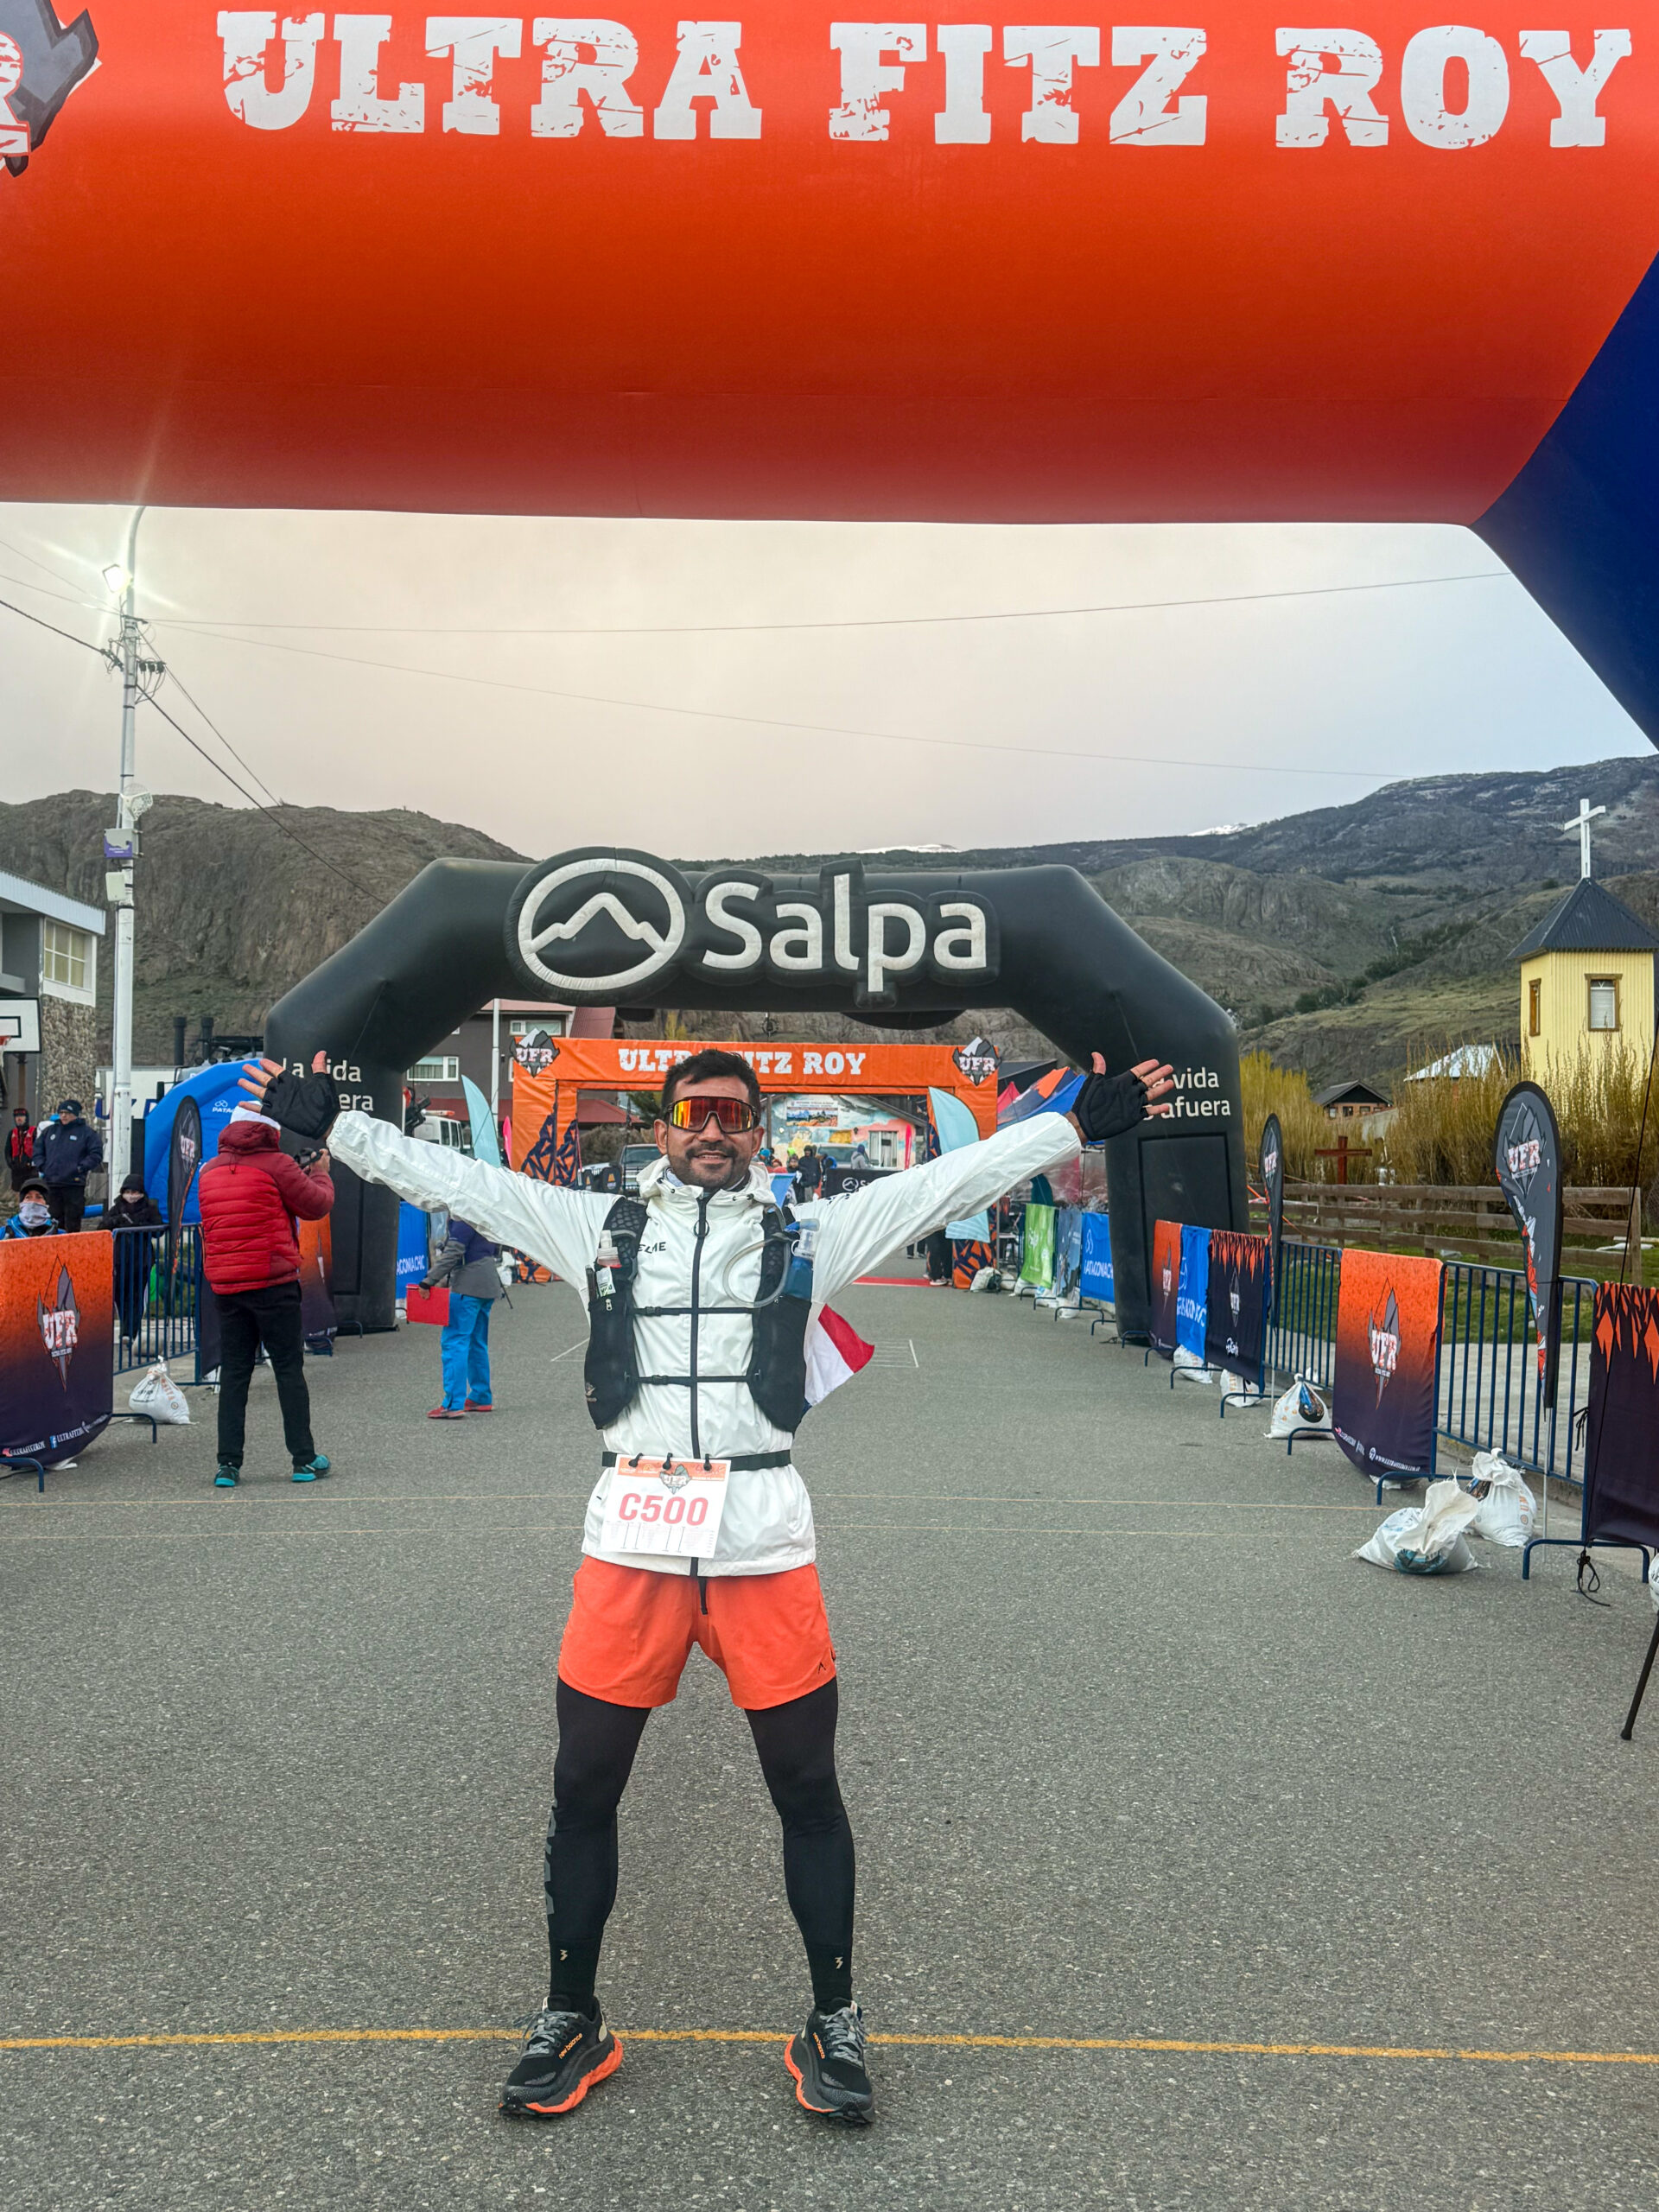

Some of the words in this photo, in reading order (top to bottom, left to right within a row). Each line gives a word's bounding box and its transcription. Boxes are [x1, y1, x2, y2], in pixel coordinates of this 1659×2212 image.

[217, 11, 761, 140] ULTRA
[829, 22, 1208, 146] FITZ
[1275, 26, 1632, 149] ROY
[702, 873, 987, 992] Salpa
[516, 1048, 553, 1063] UFR
[619, 1048, 702, 1071] ULTR
[727, 1051, 792, 1074] ITZ
[803, 1051, 866, 1075] ROY
[959, 1057, 995, 1071] UFR
[1173, 1066, 1219, 1089] vida
[338, 1093, 373, 1111] era
[1160, 1096, 1230, 1119] afuera
[1508, 1140, 1541, 1173] UFR
[42, 1310, 78, 1349] UFR
[1371, 1329, 1397, 1370] UFR
[619, 1493, 709, 1526] C500
